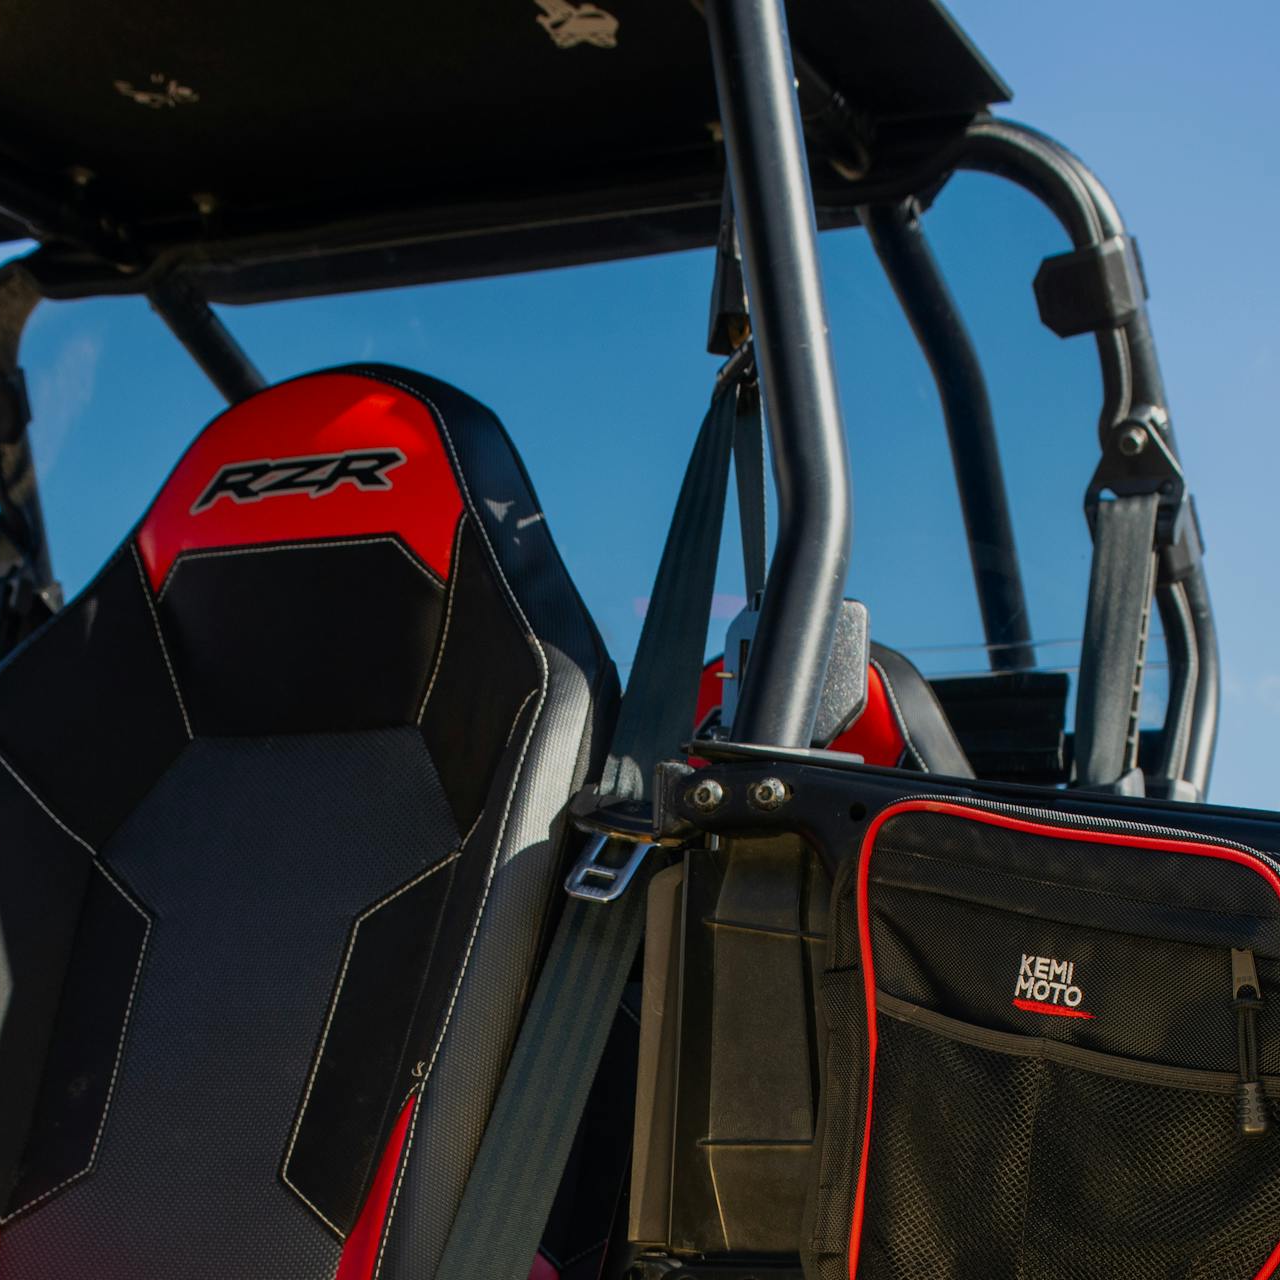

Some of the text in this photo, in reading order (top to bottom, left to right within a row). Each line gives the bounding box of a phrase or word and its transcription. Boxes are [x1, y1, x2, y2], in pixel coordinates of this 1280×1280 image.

[189, 447, 408, 516] RZR
[1020, 953, 1075, 985] KEMI
[1014, 974, 1083, 1007] MOTO
